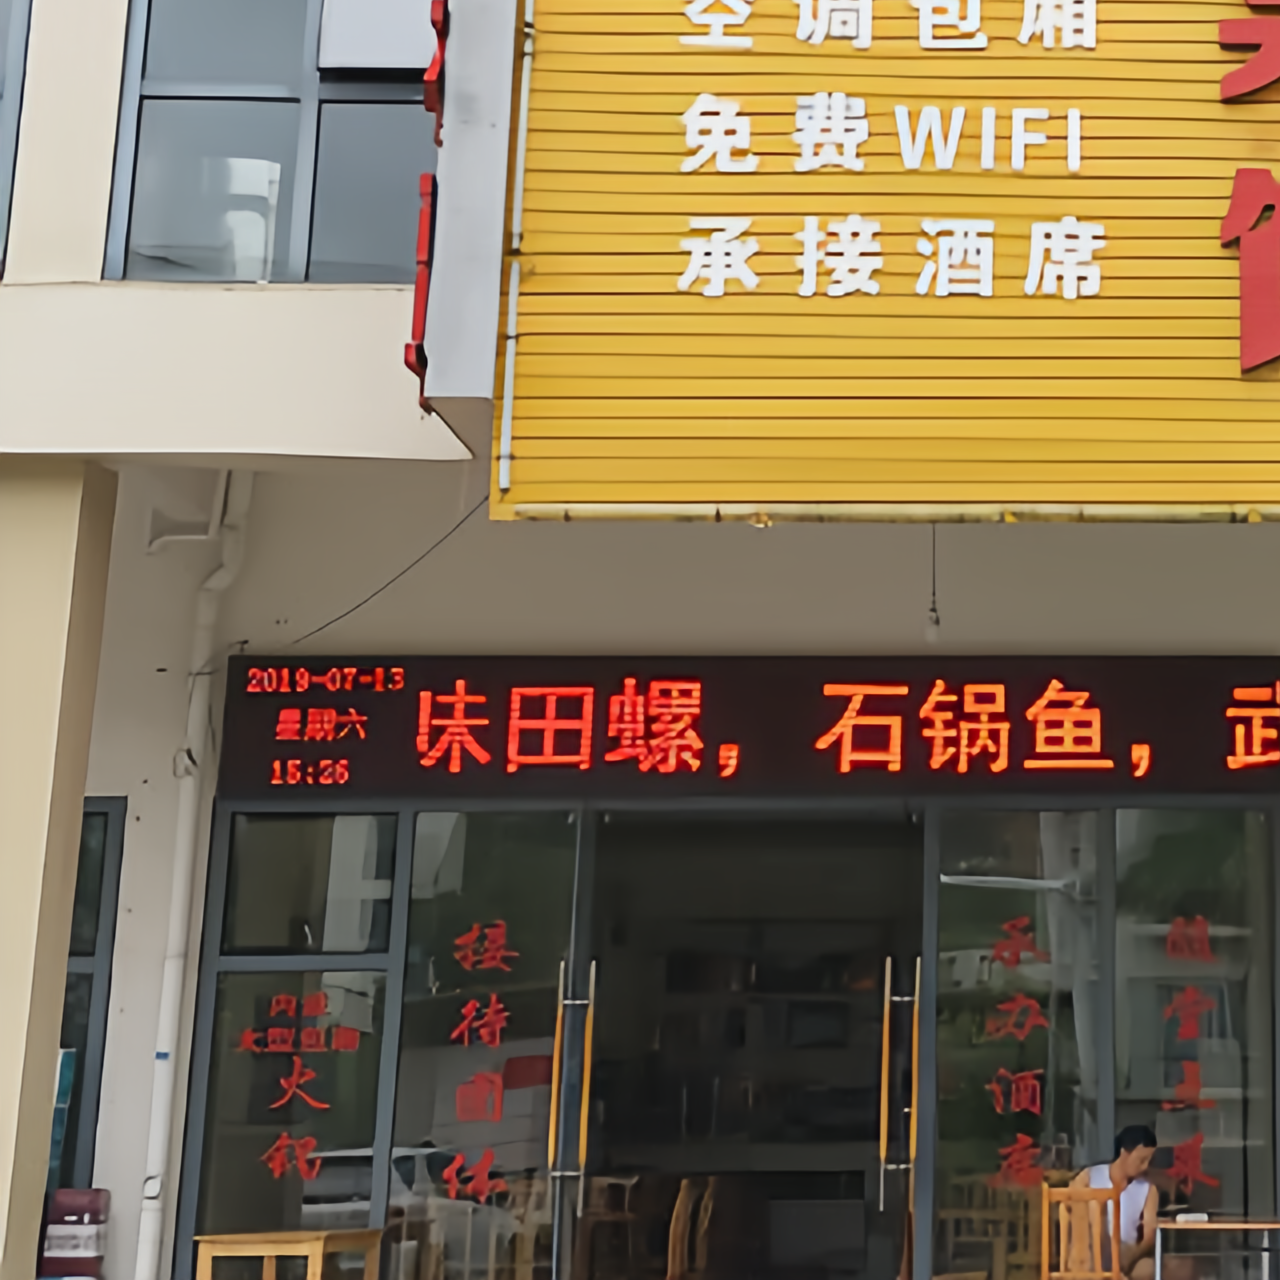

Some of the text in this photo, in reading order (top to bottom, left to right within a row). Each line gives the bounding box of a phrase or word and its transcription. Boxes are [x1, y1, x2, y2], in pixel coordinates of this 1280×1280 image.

[677, 214, 1107, 299] 承接酒席
[246, 666, 405, 693] 2019-07-13
